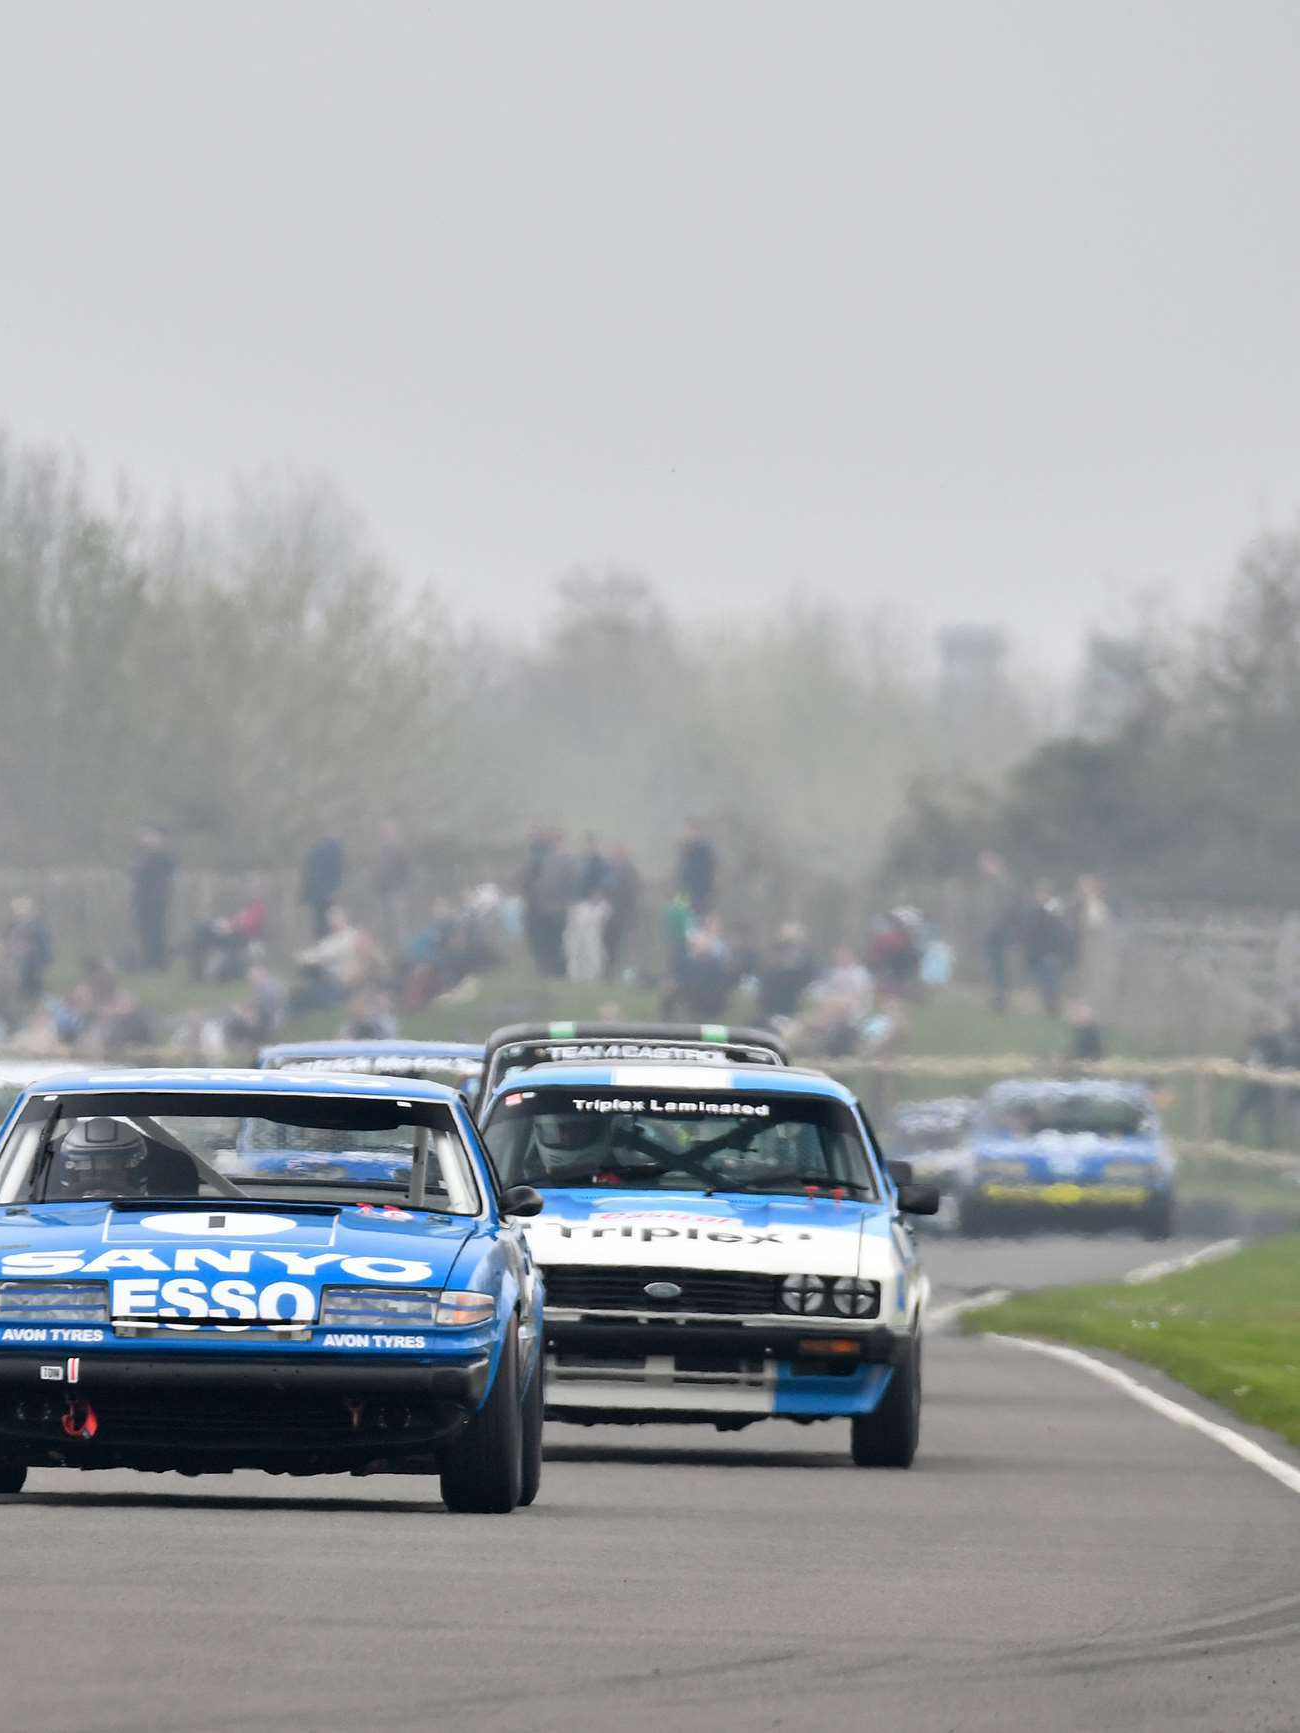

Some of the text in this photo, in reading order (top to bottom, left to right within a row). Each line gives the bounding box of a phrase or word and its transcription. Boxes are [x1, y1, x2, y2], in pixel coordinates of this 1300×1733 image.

[573, 1099, 770, 1116] Triplex Laminated
[547, 1222, 784, 1244] Triplex
[1, 1248, 434, 1283] SANYO
[112, 1278, 316, 1332] ESSO
[2, 1329, 104, 1342] AVON TYRES
[322, 1334, 425, 1348] AVON TYRES
